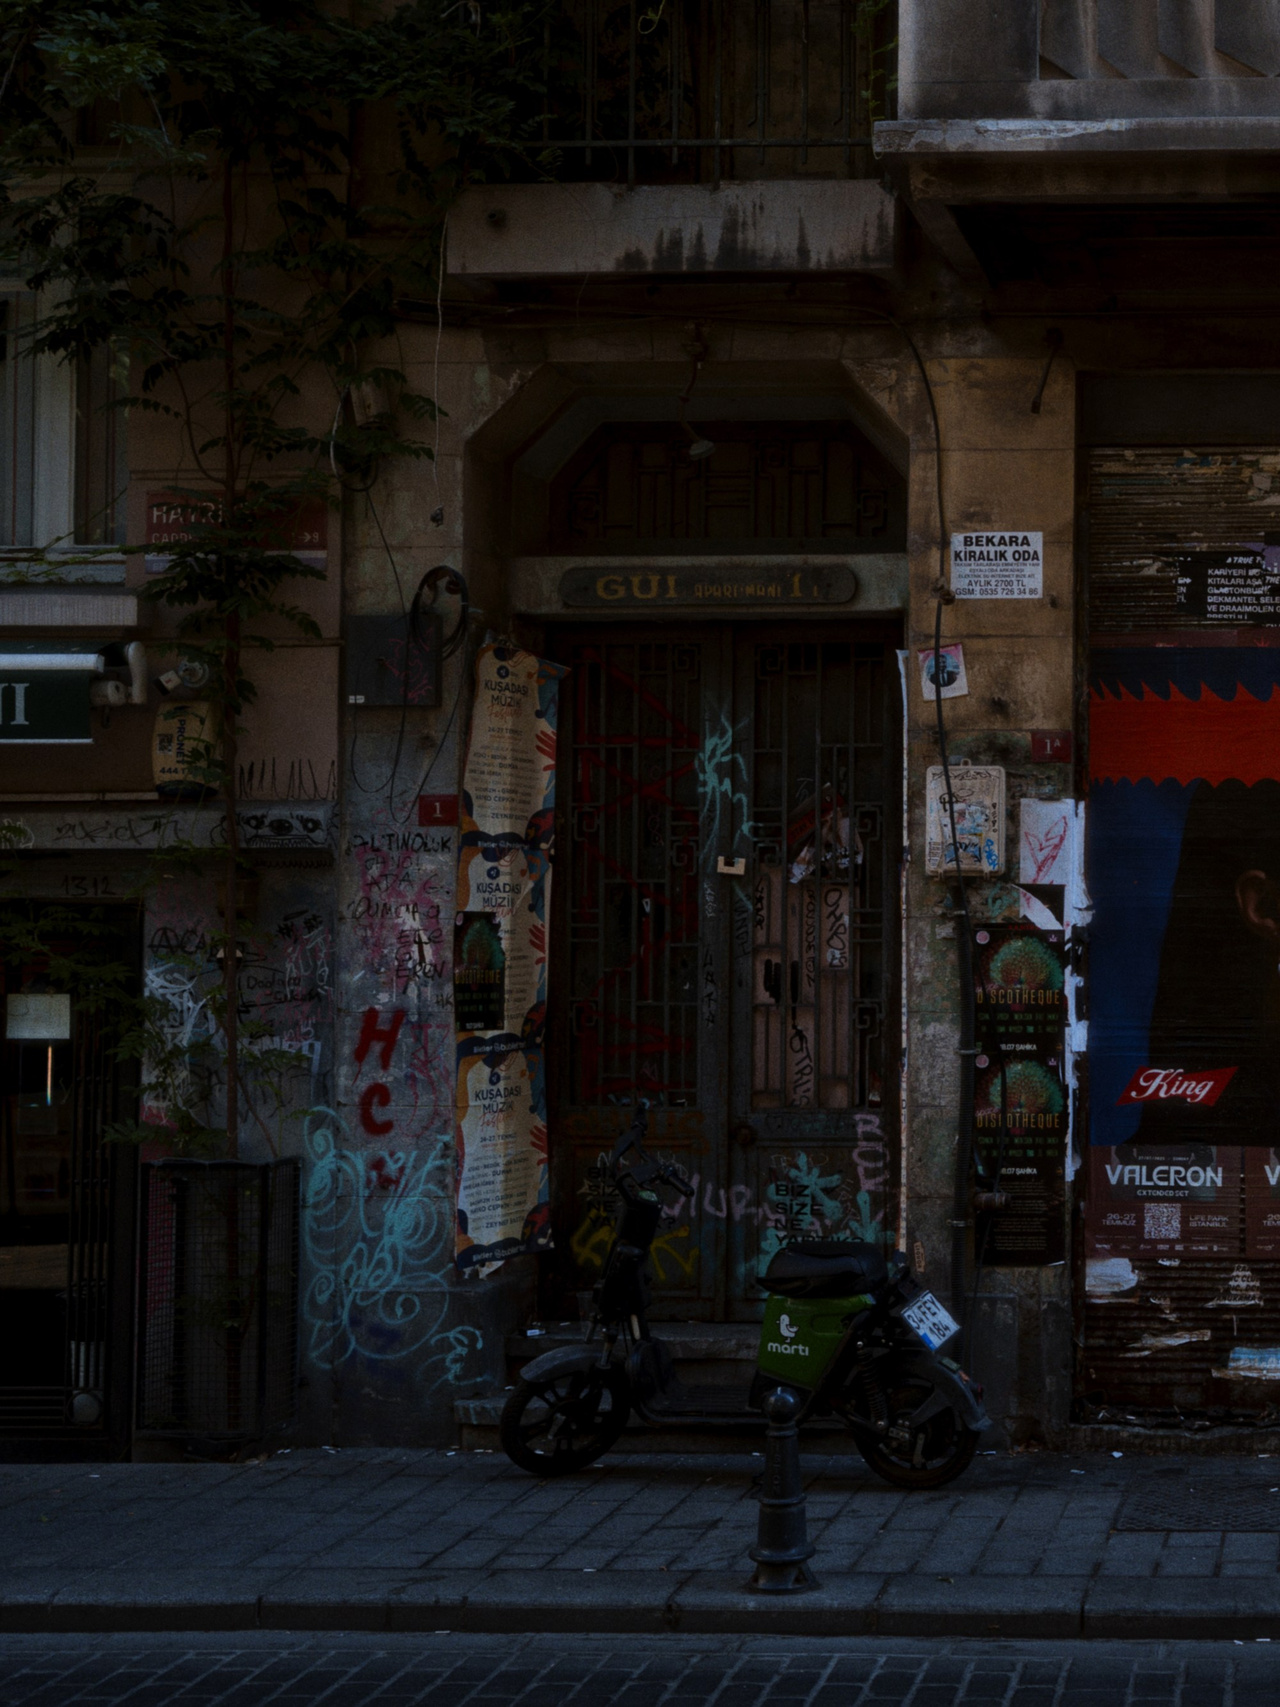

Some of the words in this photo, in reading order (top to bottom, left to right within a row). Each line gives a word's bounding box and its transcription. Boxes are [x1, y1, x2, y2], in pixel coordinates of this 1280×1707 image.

[963, 535, 1031, 547] BEKARA
[953, 548, 1008, 562] KİRALIK
[1012, 550, 1040, 562] ODA
[967, 580, 992, 588] AYLIK
[994, 580, 1014, 588] 2700
[1016, 580, 1027, 588] TL
[1207, 596, 1258, 604] DEKMANTEL
[433, 803, 442, 818] 1
[976, 989, 1061, 1006] DSCOTHEQUE
[1130, 1068, 1215, 1103] King
[1105, 1164, 1223, 1187] VALERON
[1136, 1190, 1174, 1198] EXTENDED
[1175, 1190, 1190, 1198] SET
[774, 1218, 804, 1232] NE
